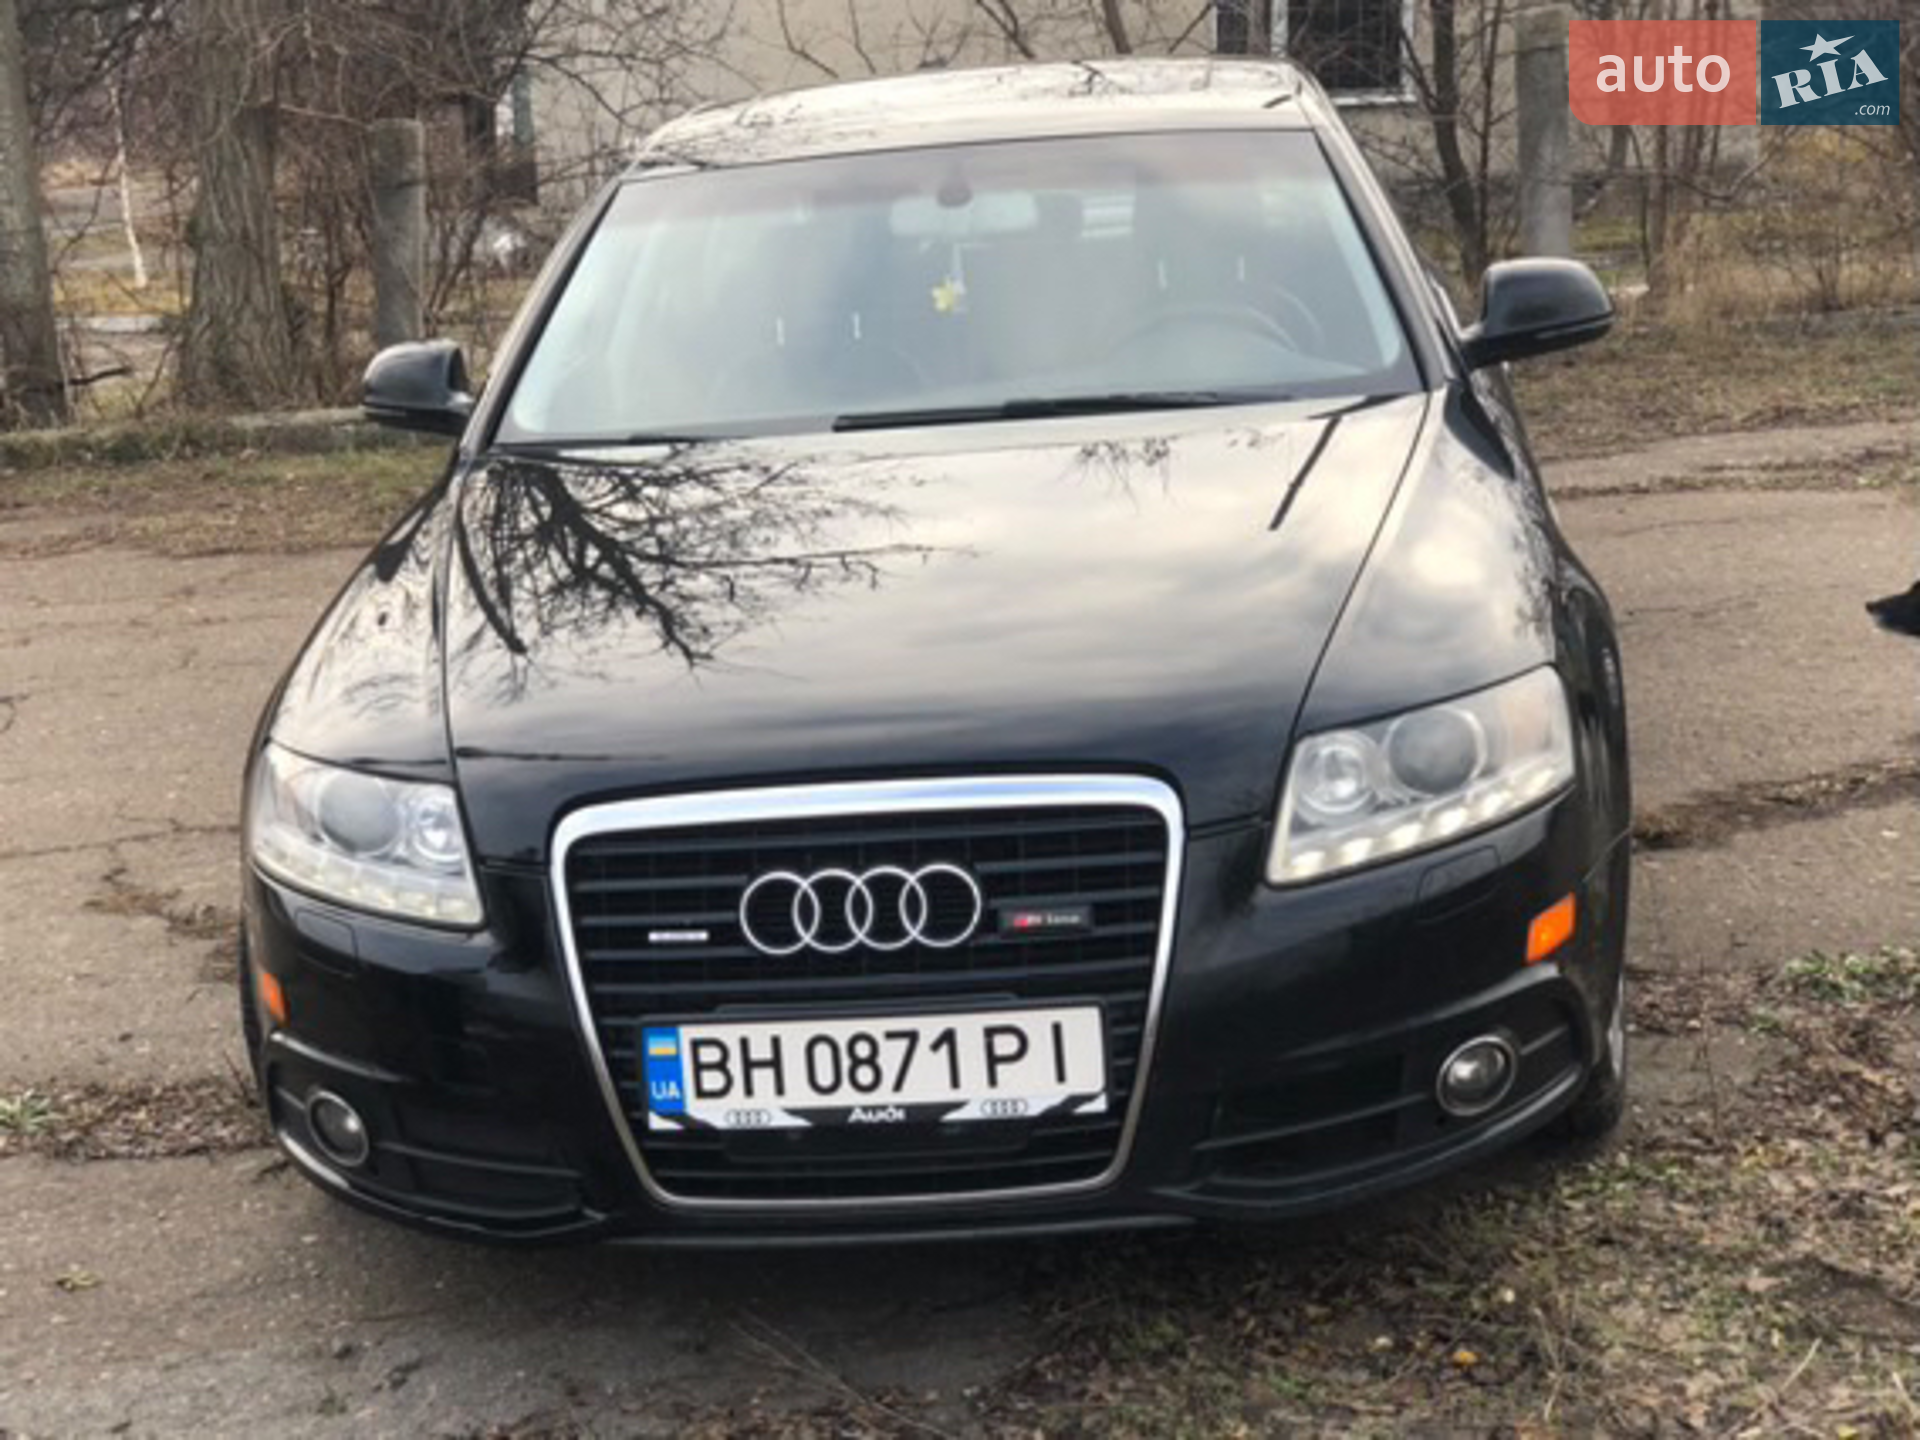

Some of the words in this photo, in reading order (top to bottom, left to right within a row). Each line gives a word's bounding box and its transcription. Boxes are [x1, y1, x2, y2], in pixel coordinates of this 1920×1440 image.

[690, 1034, 785, 1099] BH
[805, 1027, 961, 1096] 0871
[651, 1081, 681, 1100] UA
